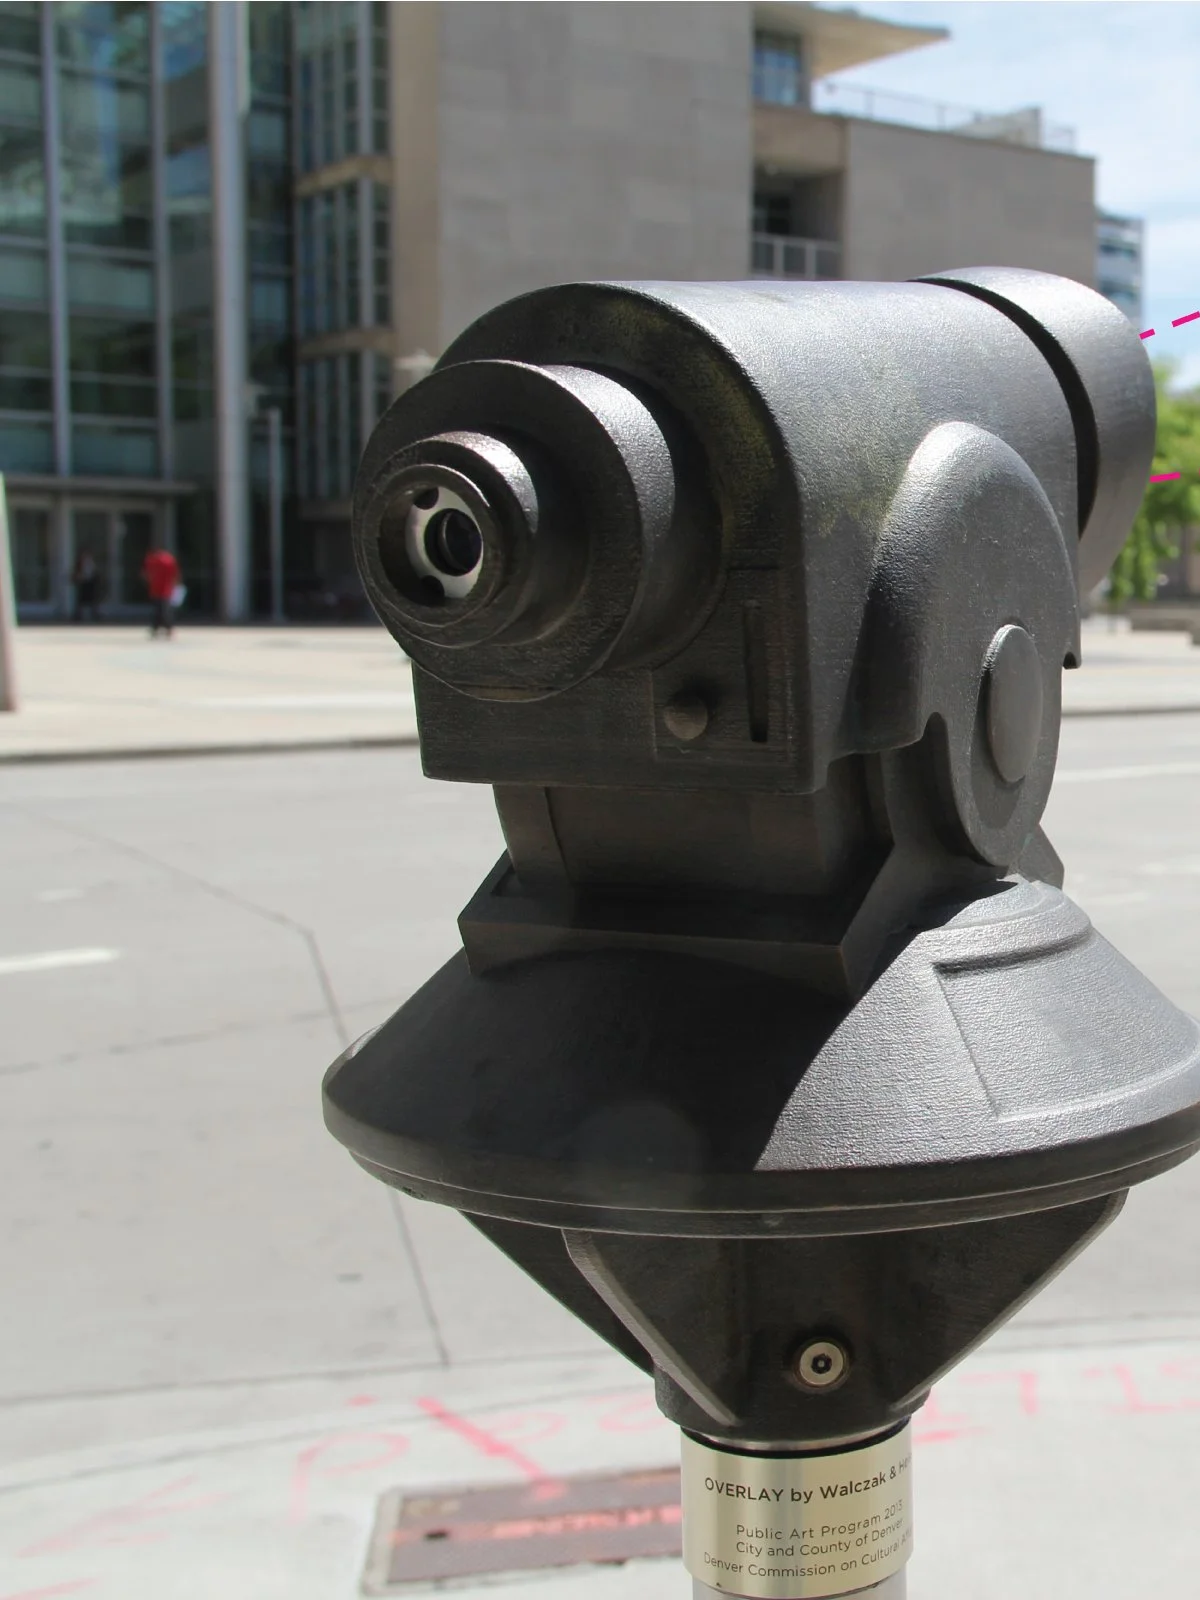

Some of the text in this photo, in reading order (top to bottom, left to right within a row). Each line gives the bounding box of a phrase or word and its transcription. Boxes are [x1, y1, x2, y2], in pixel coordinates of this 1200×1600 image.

[704, 1477, 784, 1502] OVERLAY
[790, 1487, 813, 1504] by
[819, 1471, 886, 1499] Walczak
[889, 1465, 897, 1480] &
[736, 1499, 903, 1540] Public Art Program 2013
[736, 1518, 903, 1558] City and County of Denver
[704, 1551, 744, 1573] Denver
[748, 1563, 836, 1577] Commission
[840, 1559, 857, 1571] on
[861, 1540, 900, 1566] Cultural
